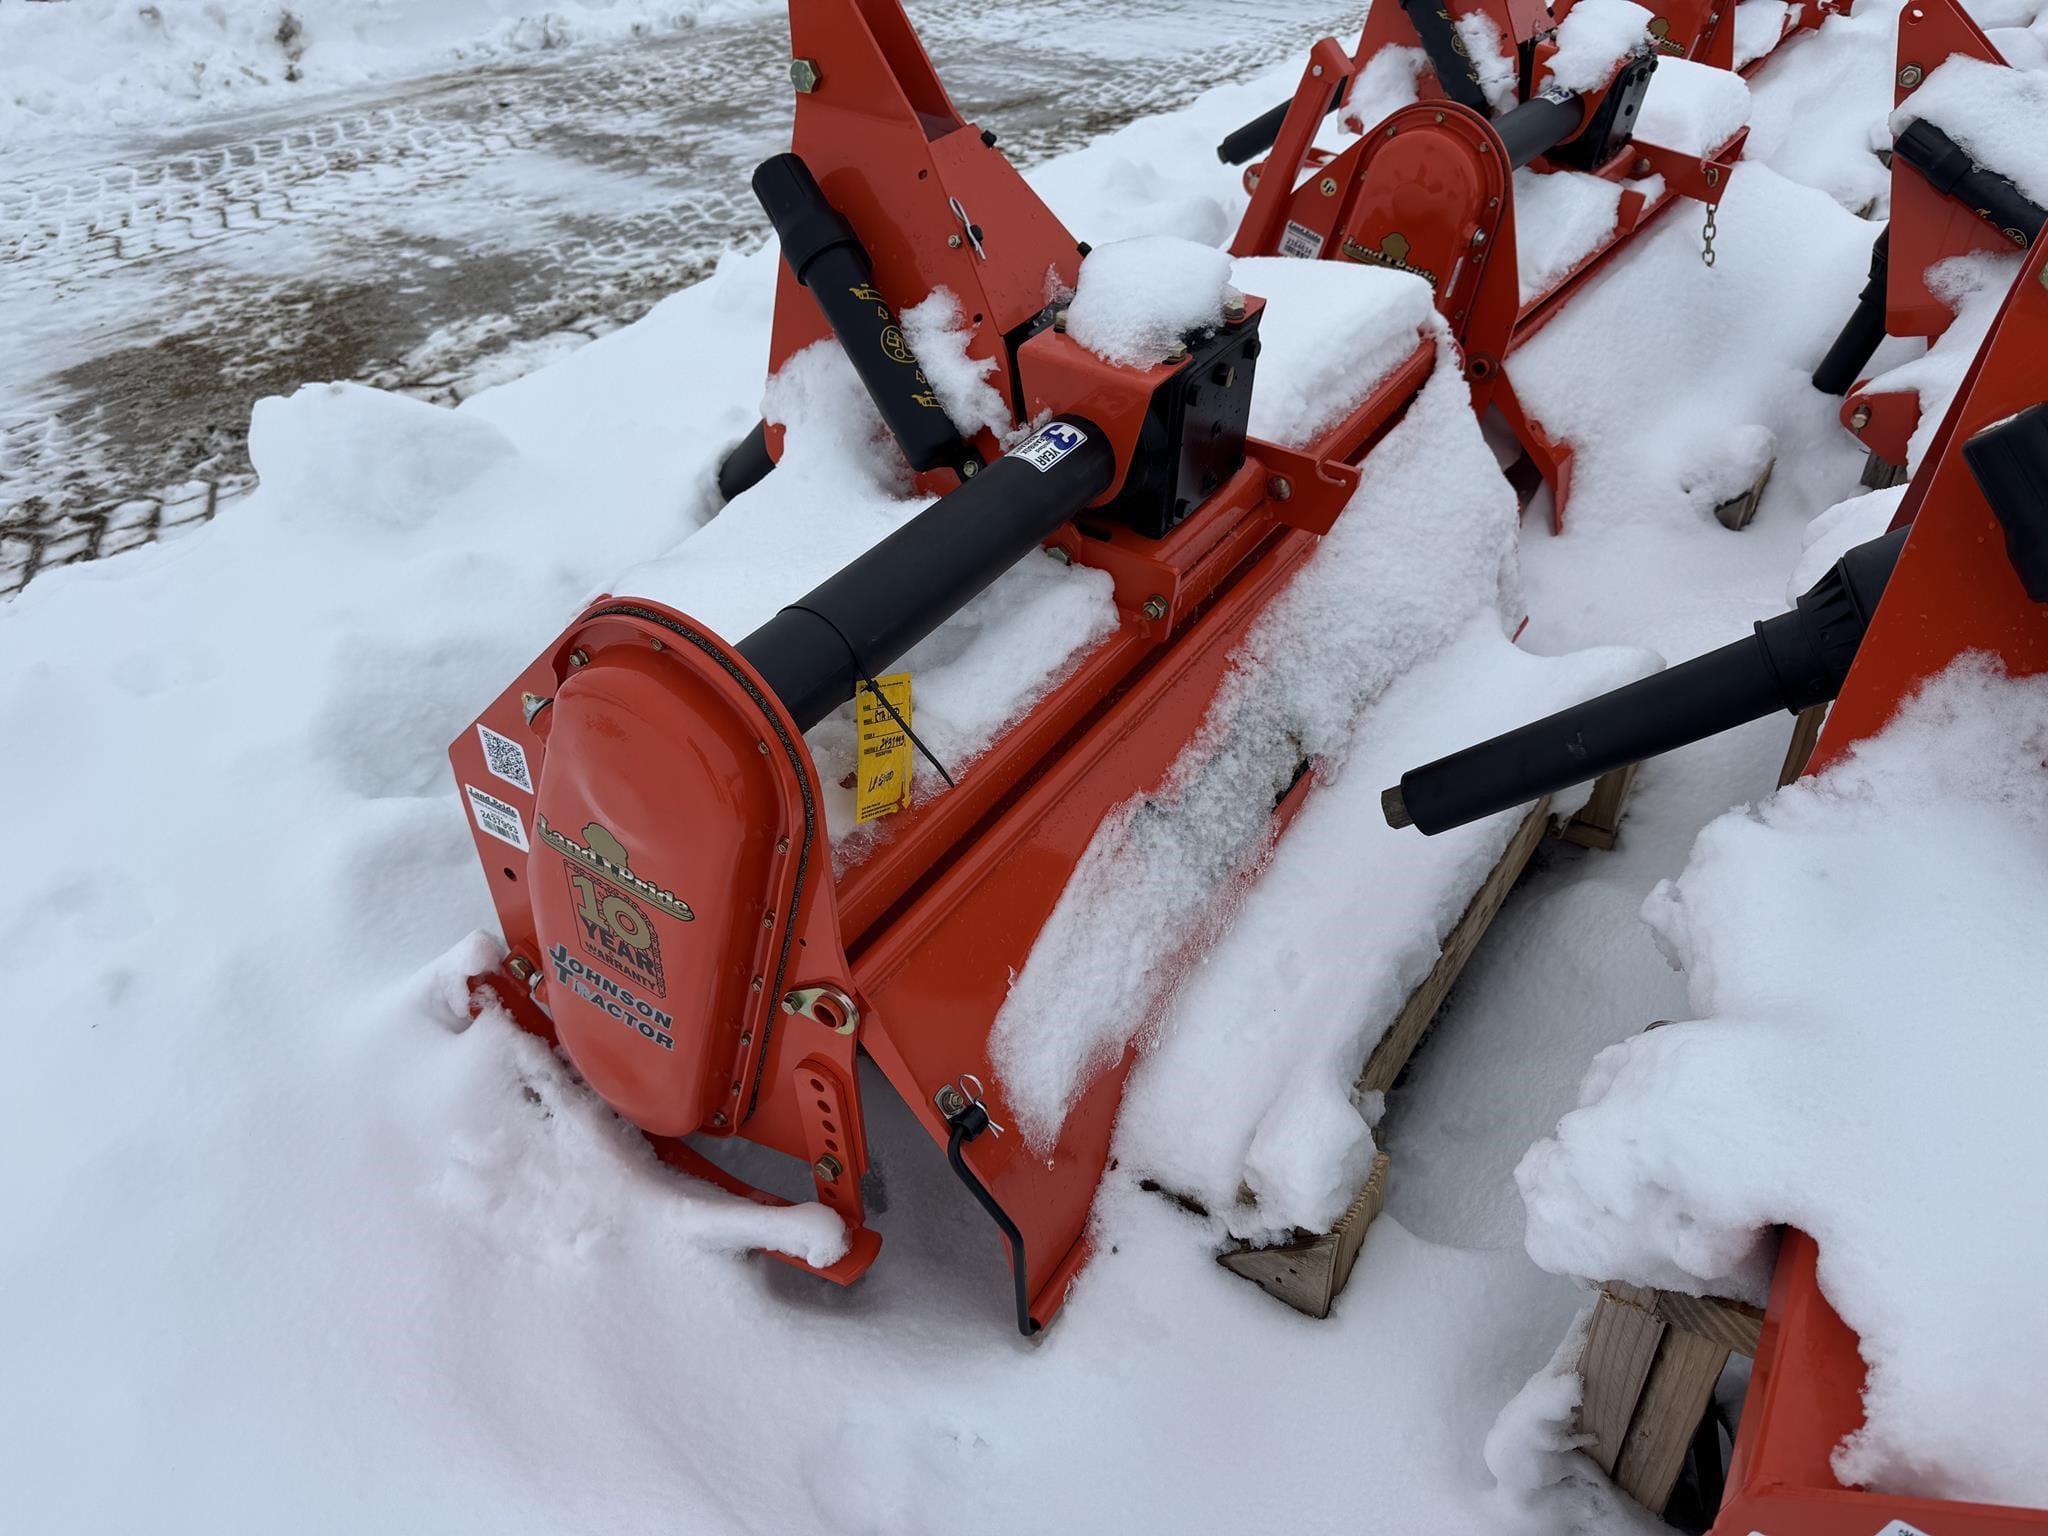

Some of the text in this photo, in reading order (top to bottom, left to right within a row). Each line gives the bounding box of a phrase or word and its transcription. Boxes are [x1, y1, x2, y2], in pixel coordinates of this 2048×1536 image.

[1035, 447, 1062, 466] YEAR
[537, 812, 694, 920] Land Pride
[571, 873, 653, 951] 10
[579, 914, 657, 977] YEAR
[549, 942, 674, 1030] JOHNSON
[584, 941, 656, 990] WARRANTY
